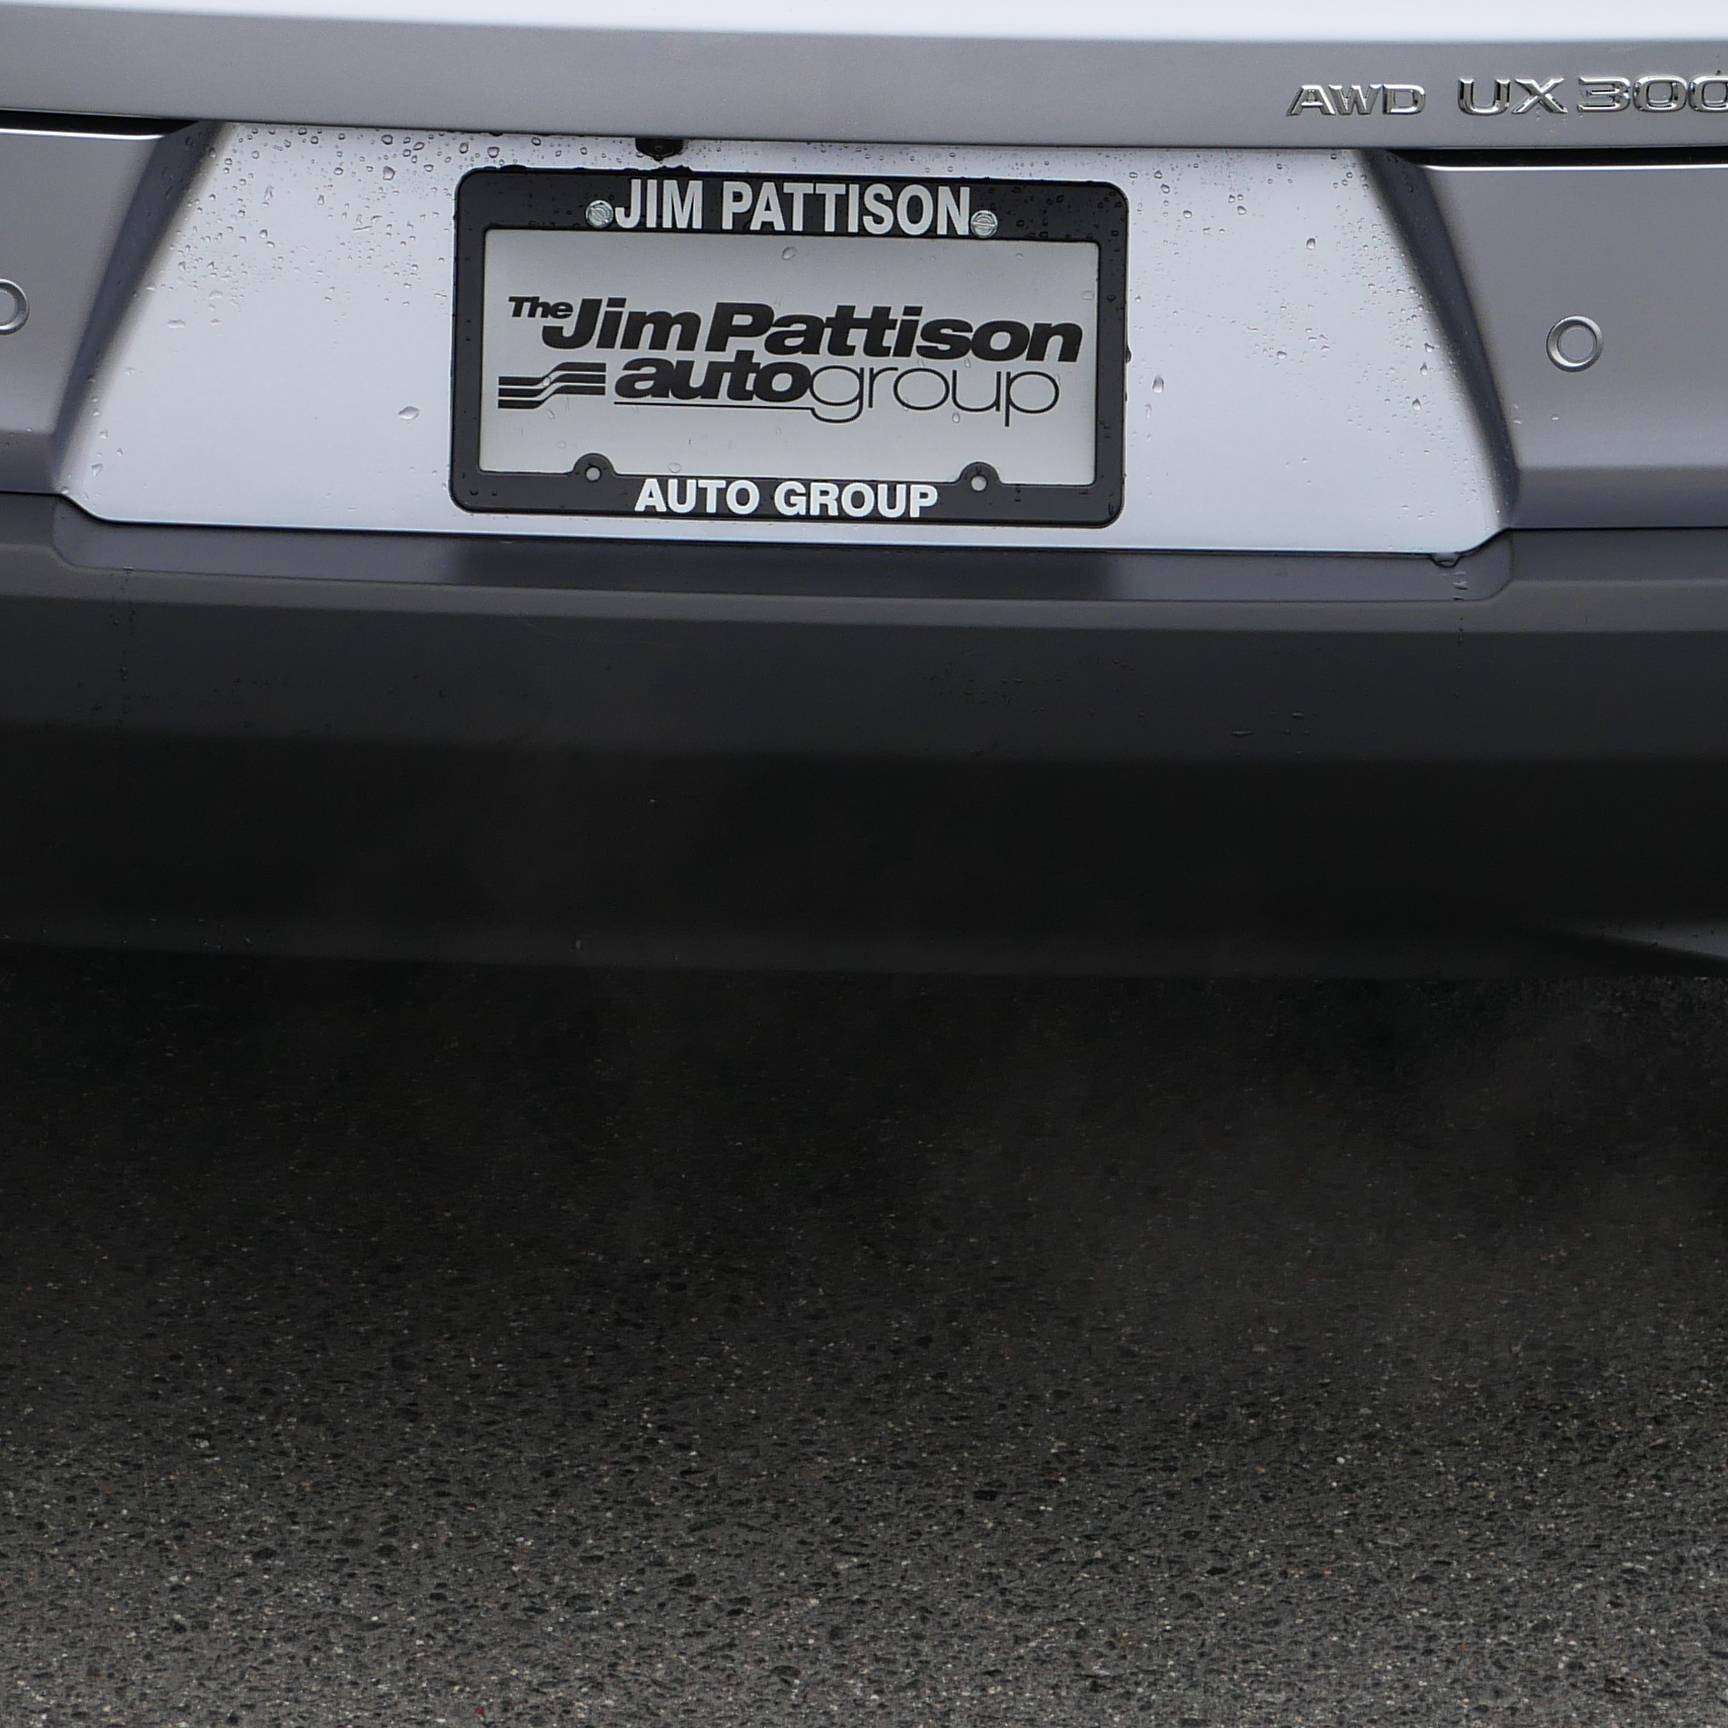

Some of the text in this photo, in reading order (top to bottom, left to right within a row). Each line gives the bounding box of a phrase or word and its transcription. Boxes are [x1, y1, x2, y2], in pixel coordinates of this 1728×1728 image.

[1286, 83, 1426, 116] AWD
[614, 178, 971, 235] JIM PATTISON
[508, 295, 574, 319] The
[634, 478, 939, 518] AUTO GROUP
